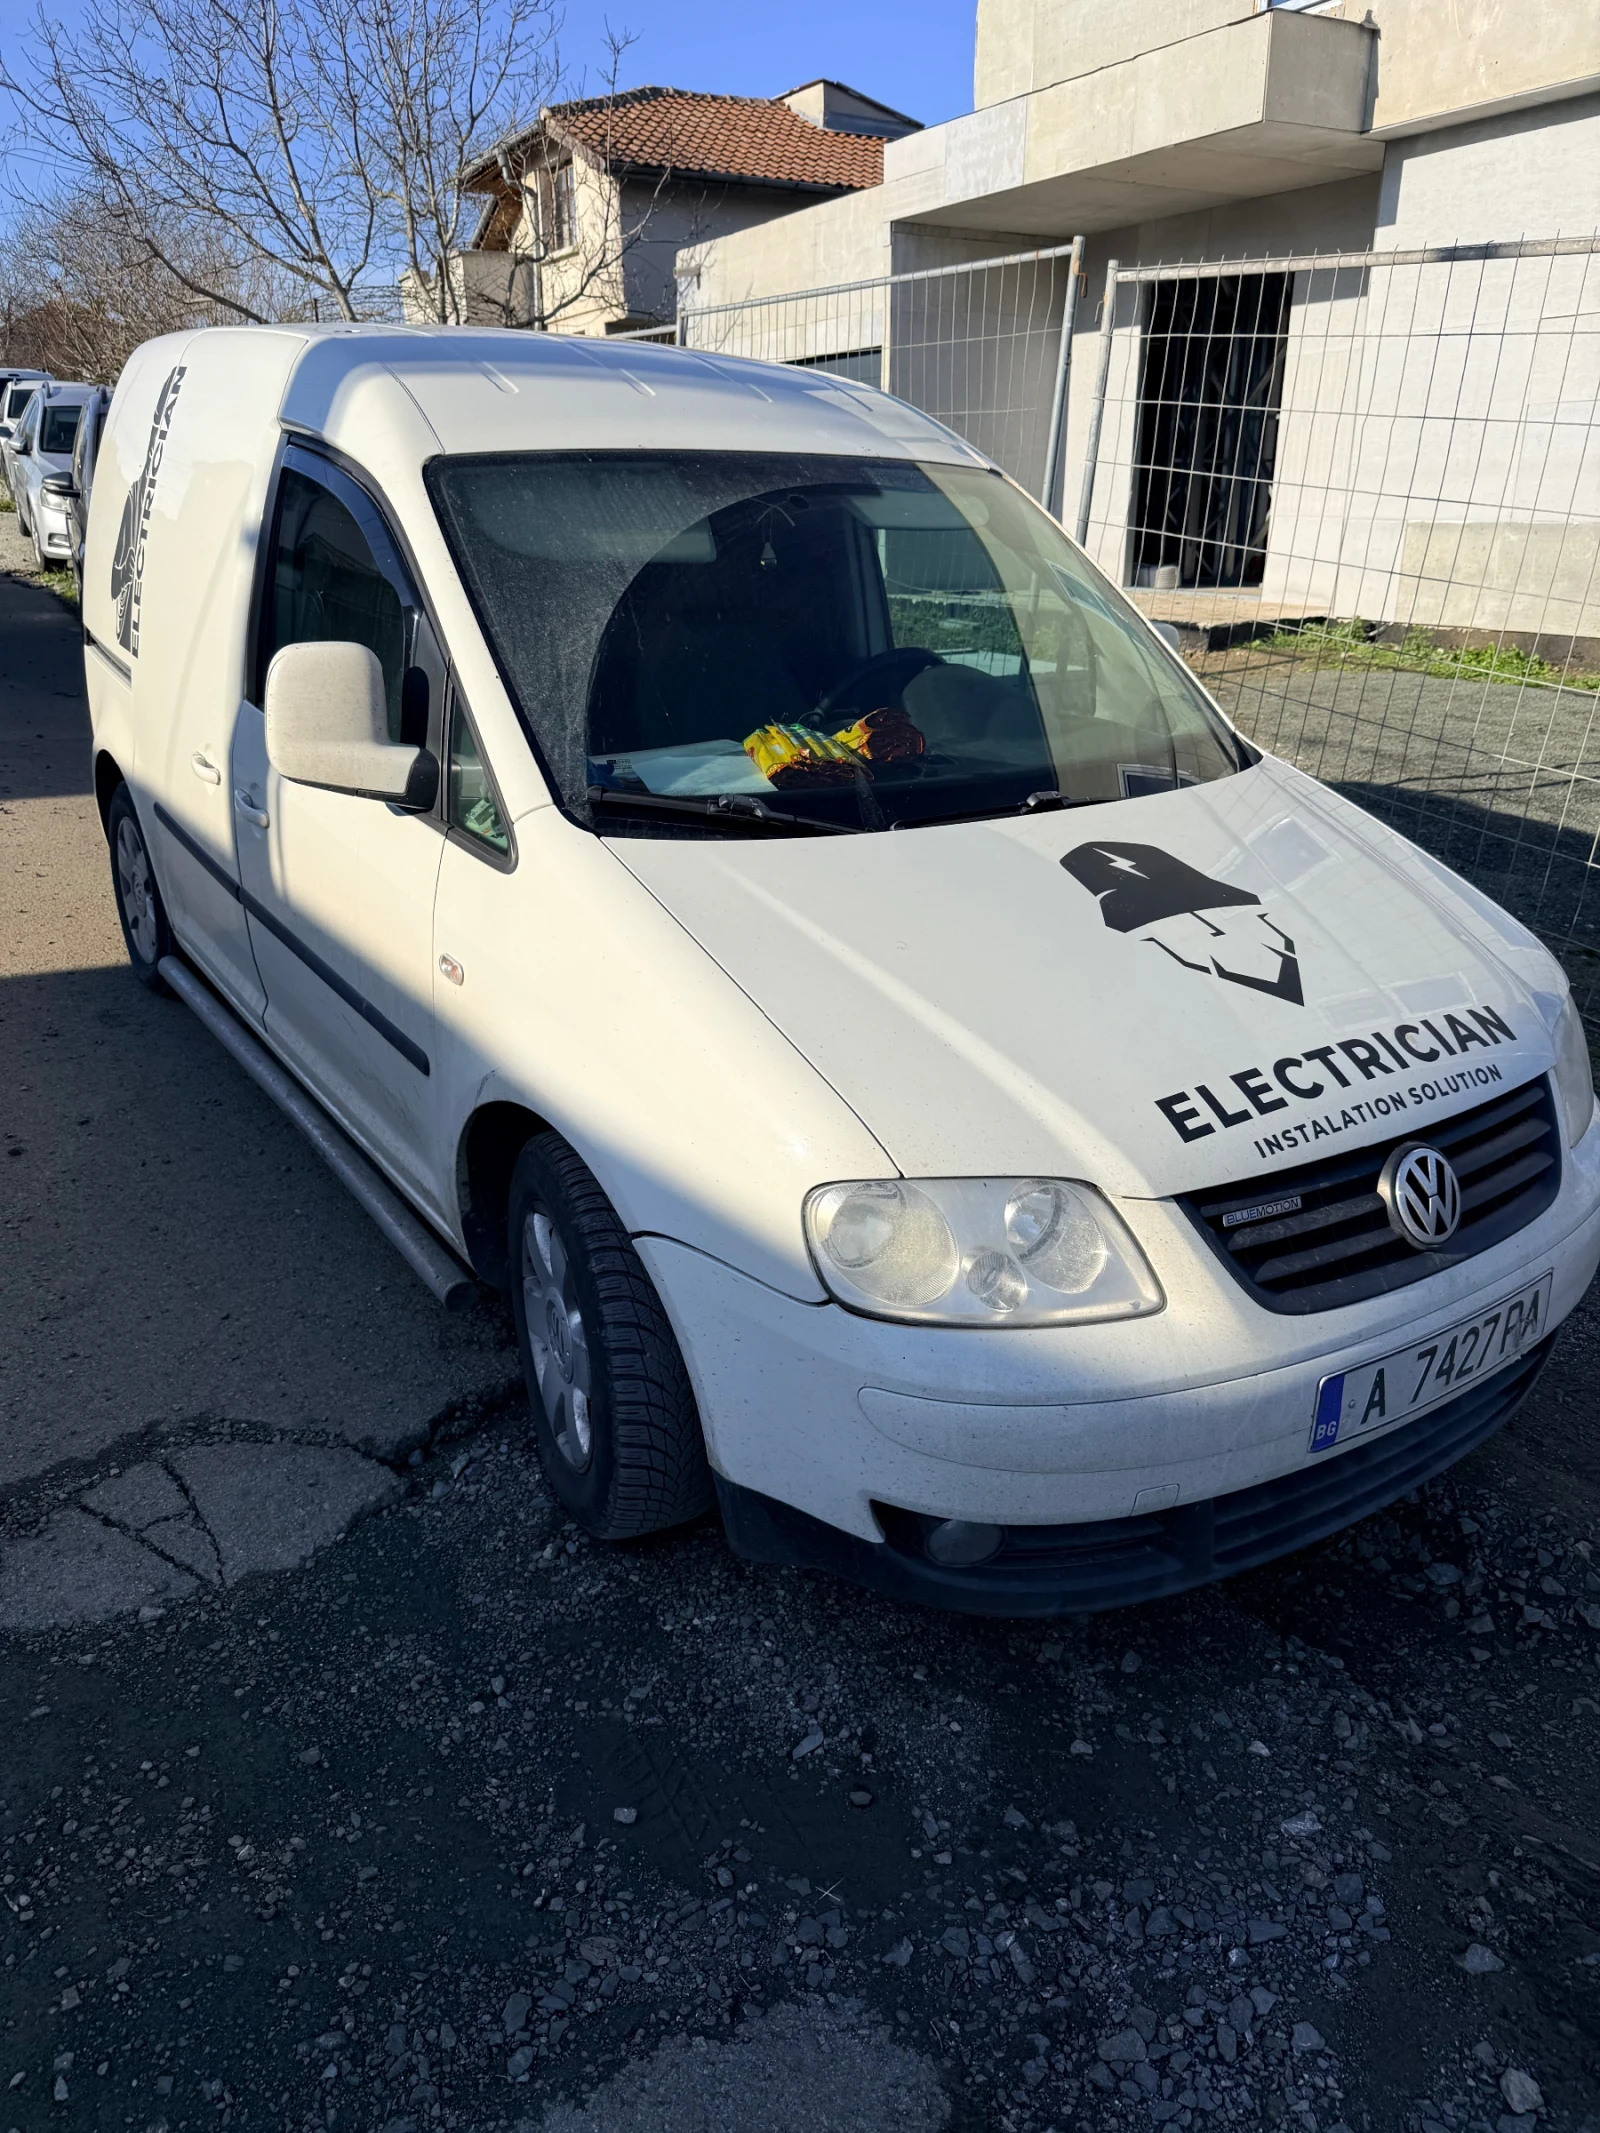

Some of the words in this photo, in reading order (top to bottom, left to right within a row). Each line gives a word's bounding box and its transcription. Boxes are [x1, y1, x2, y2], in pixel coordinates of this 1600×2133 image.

[131, 365, 188, 660] ELECTRICIAN
[1154, 1005, 1518, 1144] ELECTRICIAN
[1253, 1091, 1407, 1159] INSTALATION
[1408, 1064, 1503, 1107] SOLUTION
[1226, 1198, 1300, 1225] BLUEMOTION
[1315, 1421, 1338, 1441] BG
